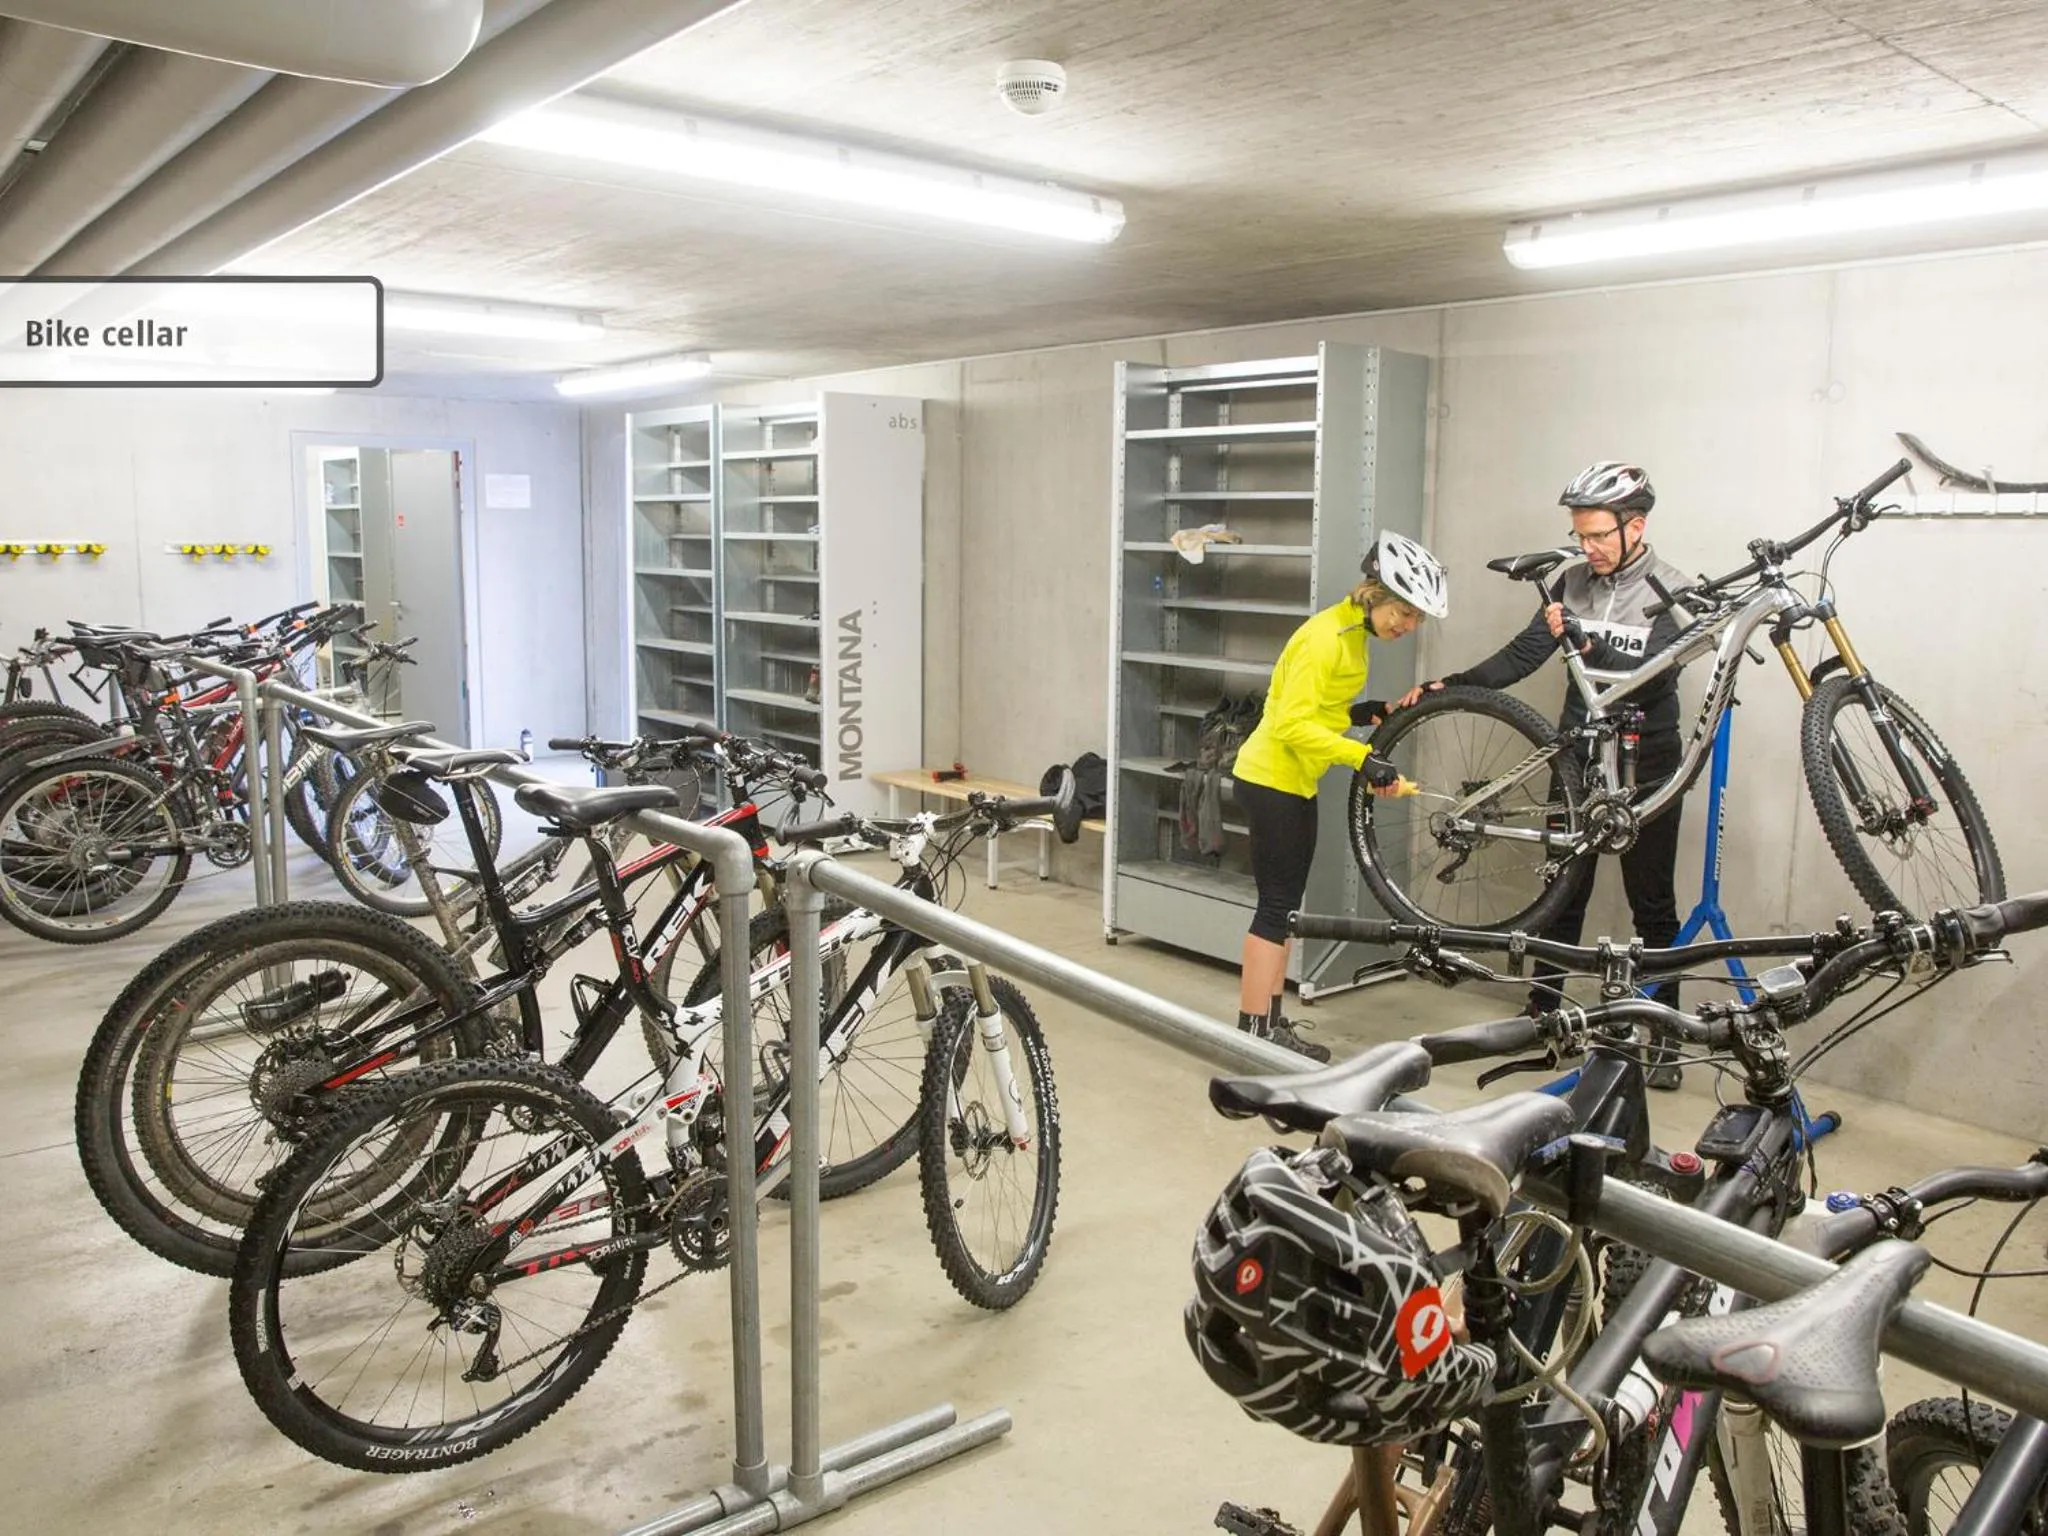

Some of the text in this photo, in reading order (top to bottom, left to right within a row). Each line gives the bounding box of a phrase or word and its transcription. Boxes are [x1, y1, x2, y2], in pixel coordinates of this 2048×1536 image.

[888, 413, 917, 430] abs
[1604, 630, 1643, 651] loja
[838, 608, 863, 782] MONTANA
[1693, 658, 1727, 741] TREK
[642, 871, 714, 975] REK
[1040, 1048, 1057, 1124] BONTRAGER
[365, 1436, 478, 1460] BONTRAGER
